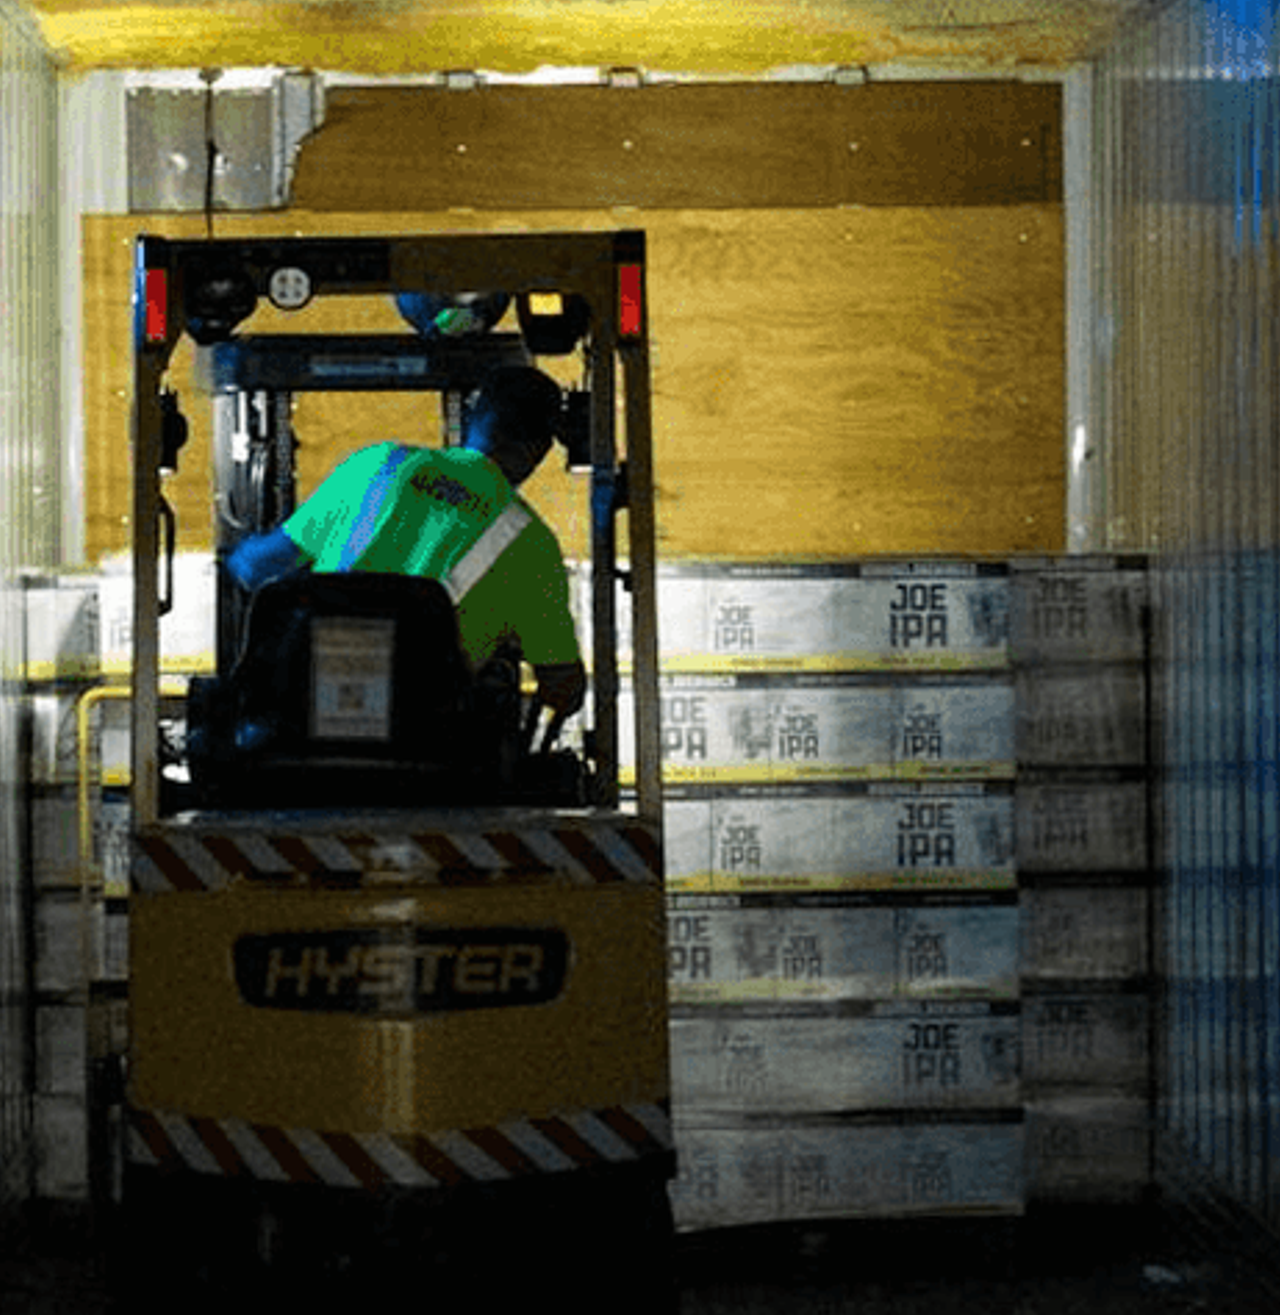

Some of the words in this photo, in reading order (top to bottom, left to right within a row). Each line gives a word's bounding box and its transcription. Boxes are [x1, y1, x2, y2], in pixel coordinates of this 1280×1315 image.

[891, 584, 948, 612] JOE
[717, 606, 753, 626] JOE
[715, 627, 754, 651] IPA
[890, 615, 948, 648] IPA
[661, 696, 707, 724] OE
[661, 727, 707, 759] PA
[779, 735, 819, 759] IPA
[903, 736, 942, 759] IPA
[898, 803, 955, 830] JOE
[722, 825, 761, 845] JOE
[721, 846, 761, 870] IPA
[897, 834, 955, 867] IPA
[669, 916, 710, 942] OE
[264, 944, 544, 998] HYSTER
[669, 946, 712, 978] PA
[904, 1024, 960, 1050] JOE
[903, 1053, 960, 1087] IPA
